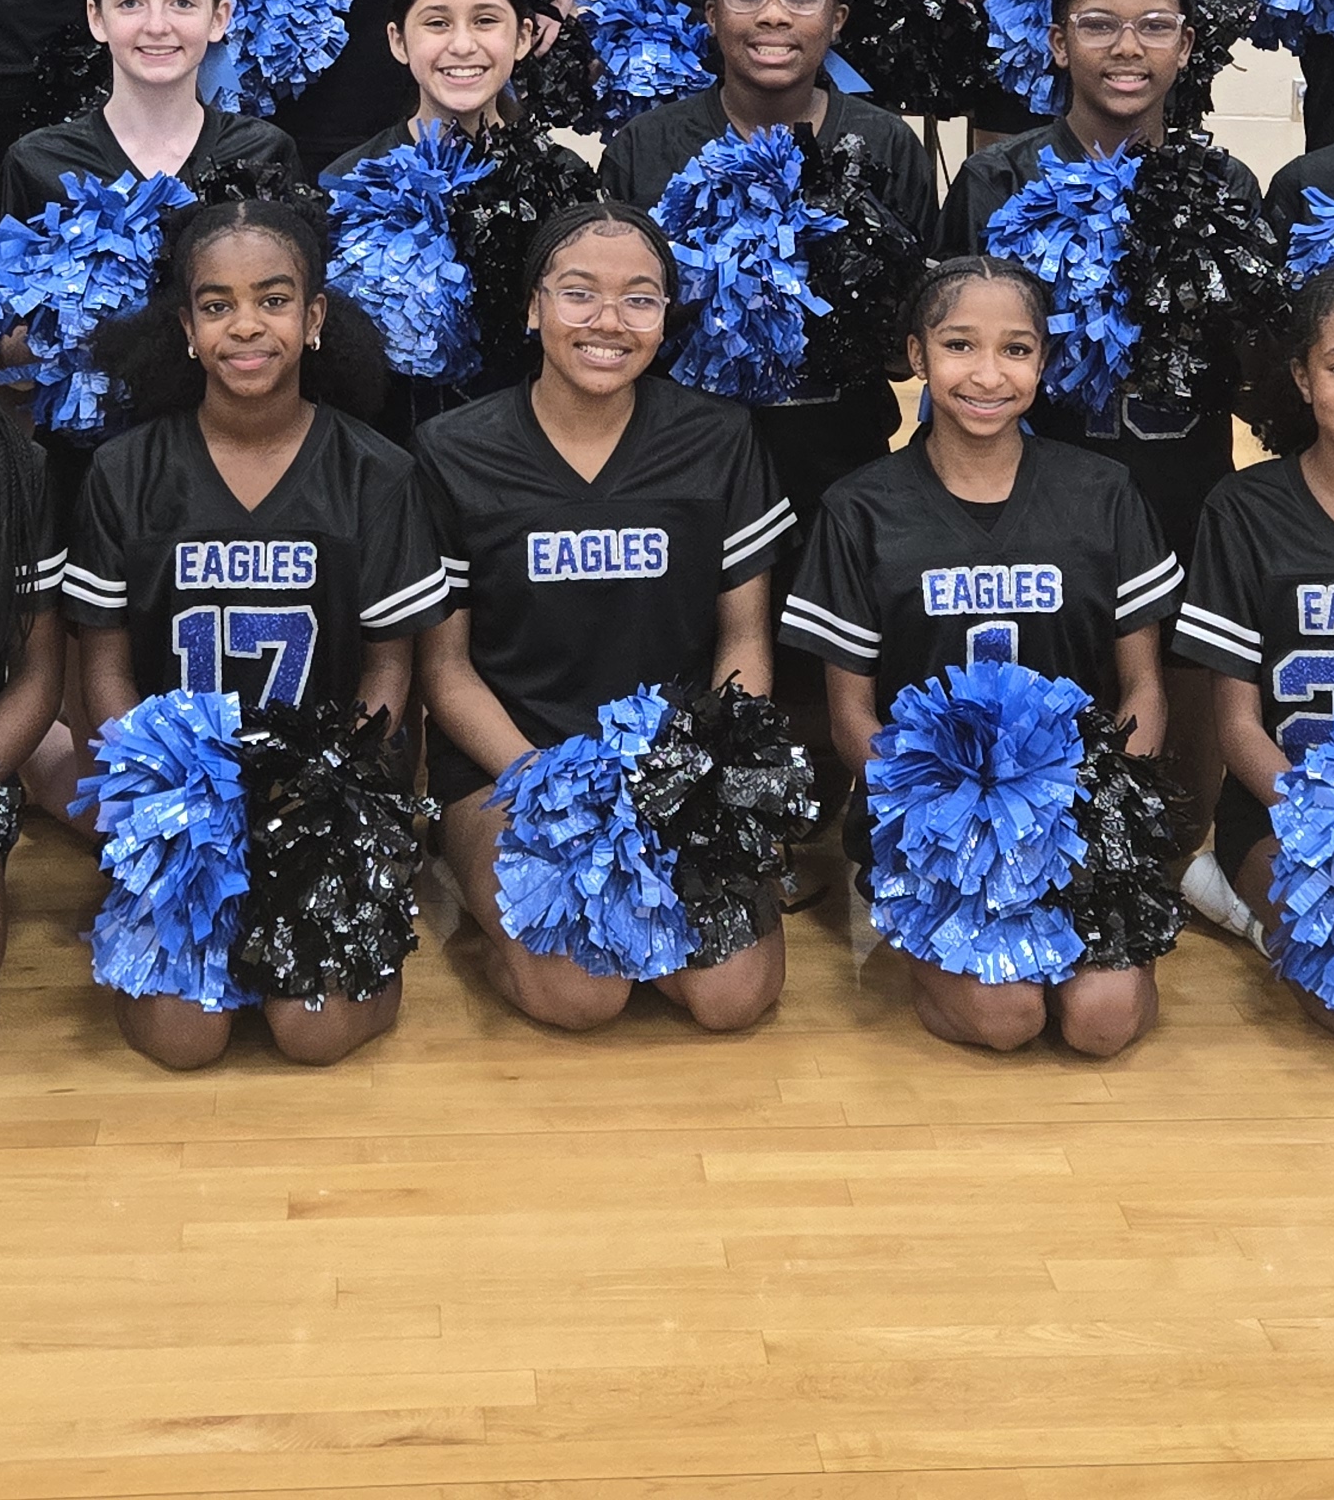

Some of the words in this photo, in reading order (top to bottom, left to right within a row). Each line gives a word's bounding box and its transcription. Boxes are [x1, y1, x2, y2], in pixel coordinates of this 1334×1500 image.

[175, 541, 317, 590] EAGLES
[528, 528, 668, 582] EAGLES
[921, 564, 1063, 616] EAGLES
[172, 605, 318, 711] 17
